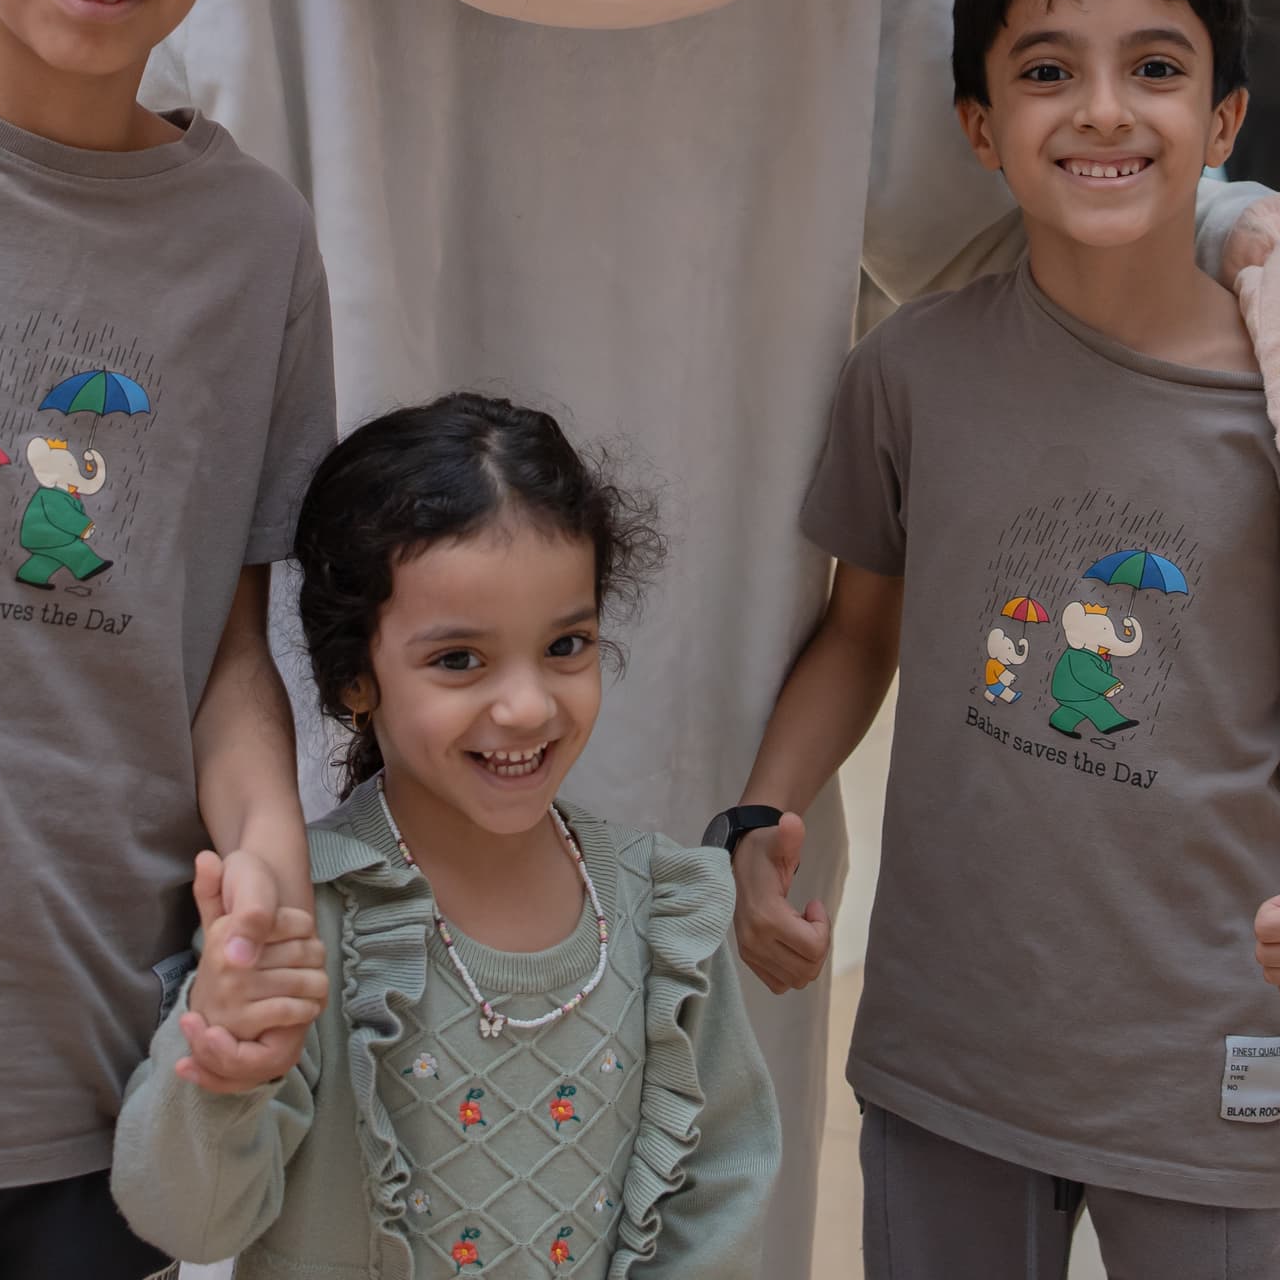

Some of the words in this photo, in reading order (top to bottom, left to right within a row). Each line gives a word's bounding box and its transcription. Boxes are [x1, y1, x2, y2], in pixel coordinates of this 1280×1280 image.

[41, 603, 78, 626] the
[84, 608, 133, 635] Day
[1012, 736, 1068, 765] saves
[1073, 750, 1106, 777] the
[1112, 761, 1159, 789] Day
[1232, 1047, 1257, 1057] FINEST
[1230, 1064, 1249, 1072] DATE
[1227, 1106, 1257, 1117] BLACK
